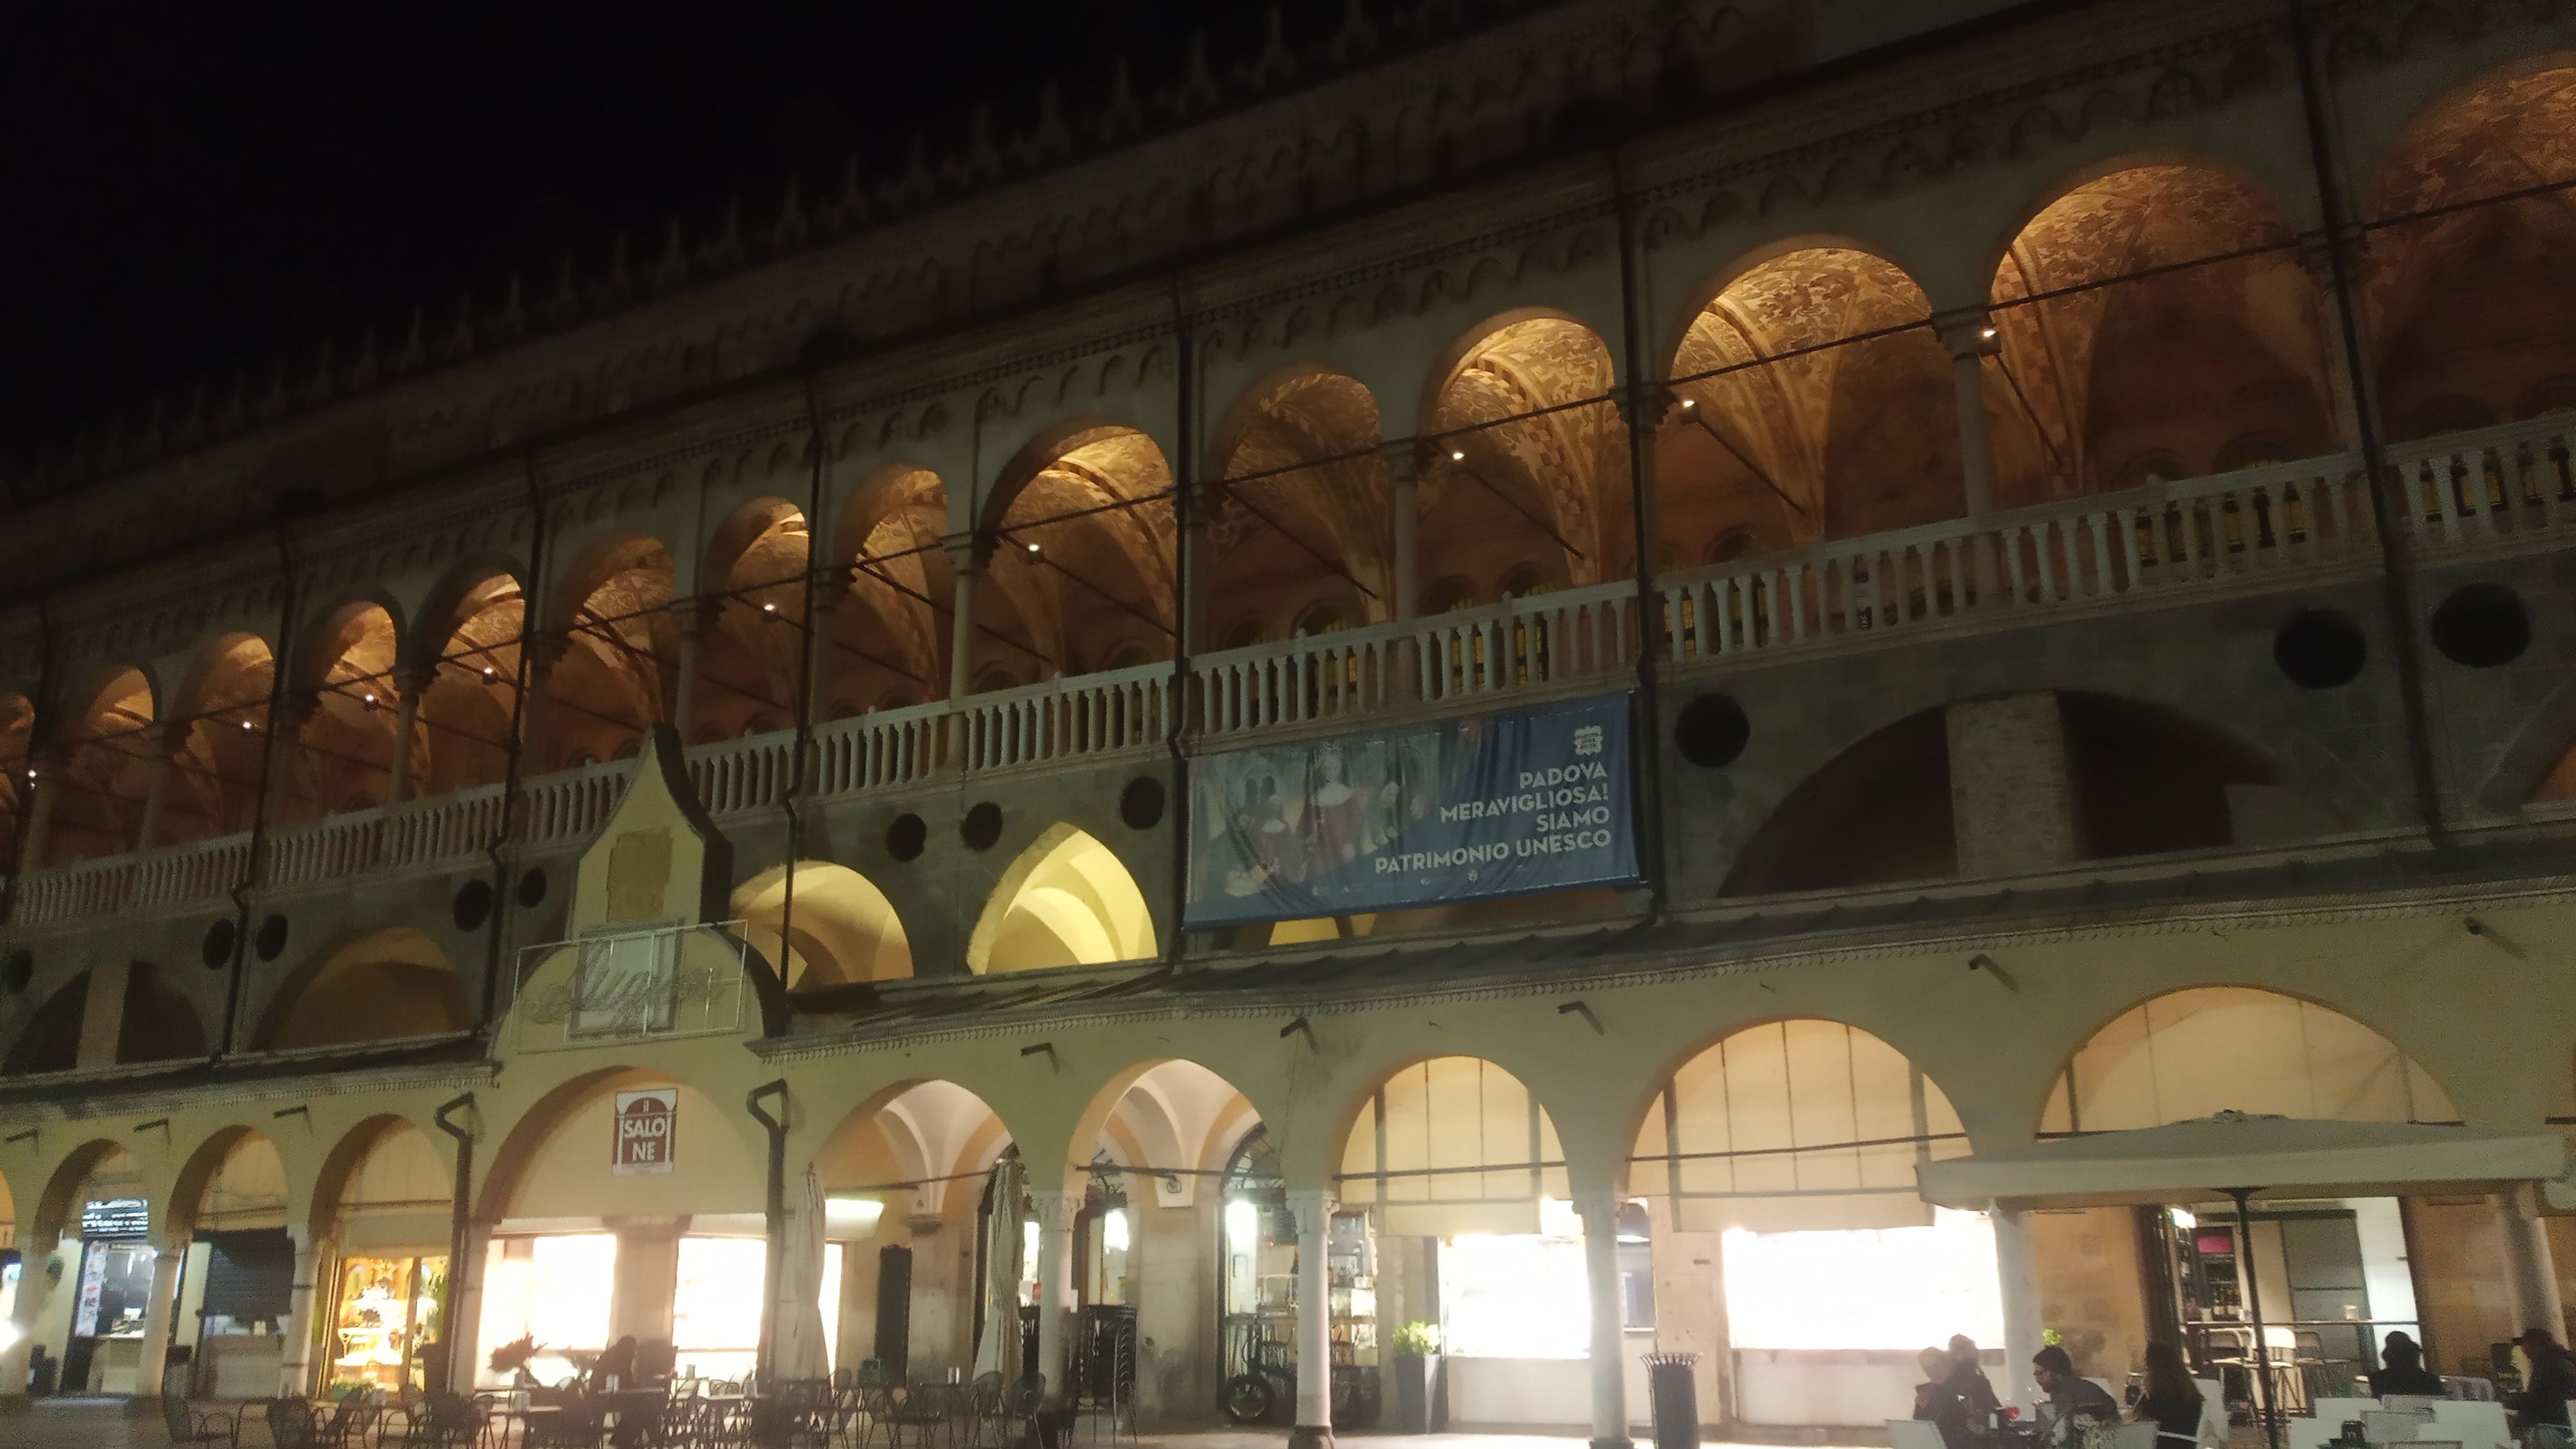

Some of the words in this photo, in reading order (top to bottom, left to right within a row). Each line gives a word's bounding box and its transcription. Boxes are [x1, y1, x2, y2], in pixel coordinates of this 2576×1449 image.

[1519, 761, 1607, 789] PADOVA
[1441, 783, 1609, 822] MERAVIGLIOSA!
[1536, 806, 1610, 833] SIAMO
[1375, 843, 1509, 874] PATRIMONIO
[1516, 829, 1611, 857] UNESCO
[624, 1117, 666, 1139] SALO
[632, 1140, 656, 1161] NE
